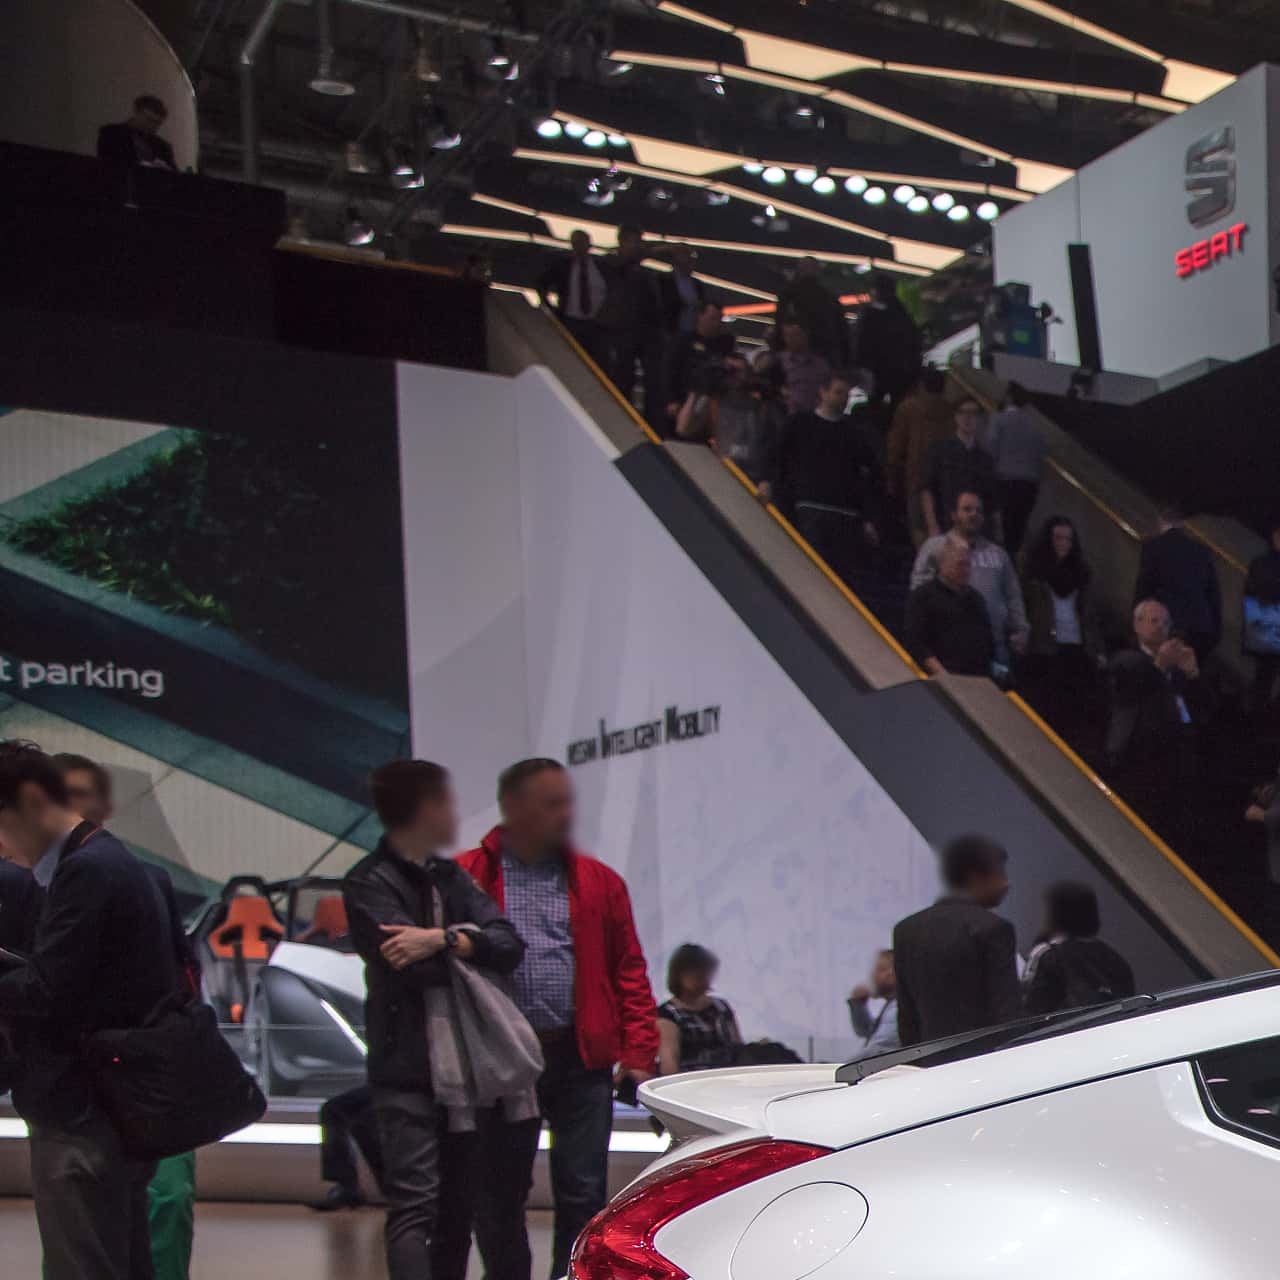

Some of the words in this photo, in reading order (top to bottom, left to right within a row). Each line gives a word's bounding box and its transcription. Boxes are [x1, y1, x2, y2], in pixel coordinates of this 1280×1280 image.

[1174, 223, 1248, 278] SEAT
[20, 660, 164, 698] parking
[665, 705, 720, 744] MOBILITY
